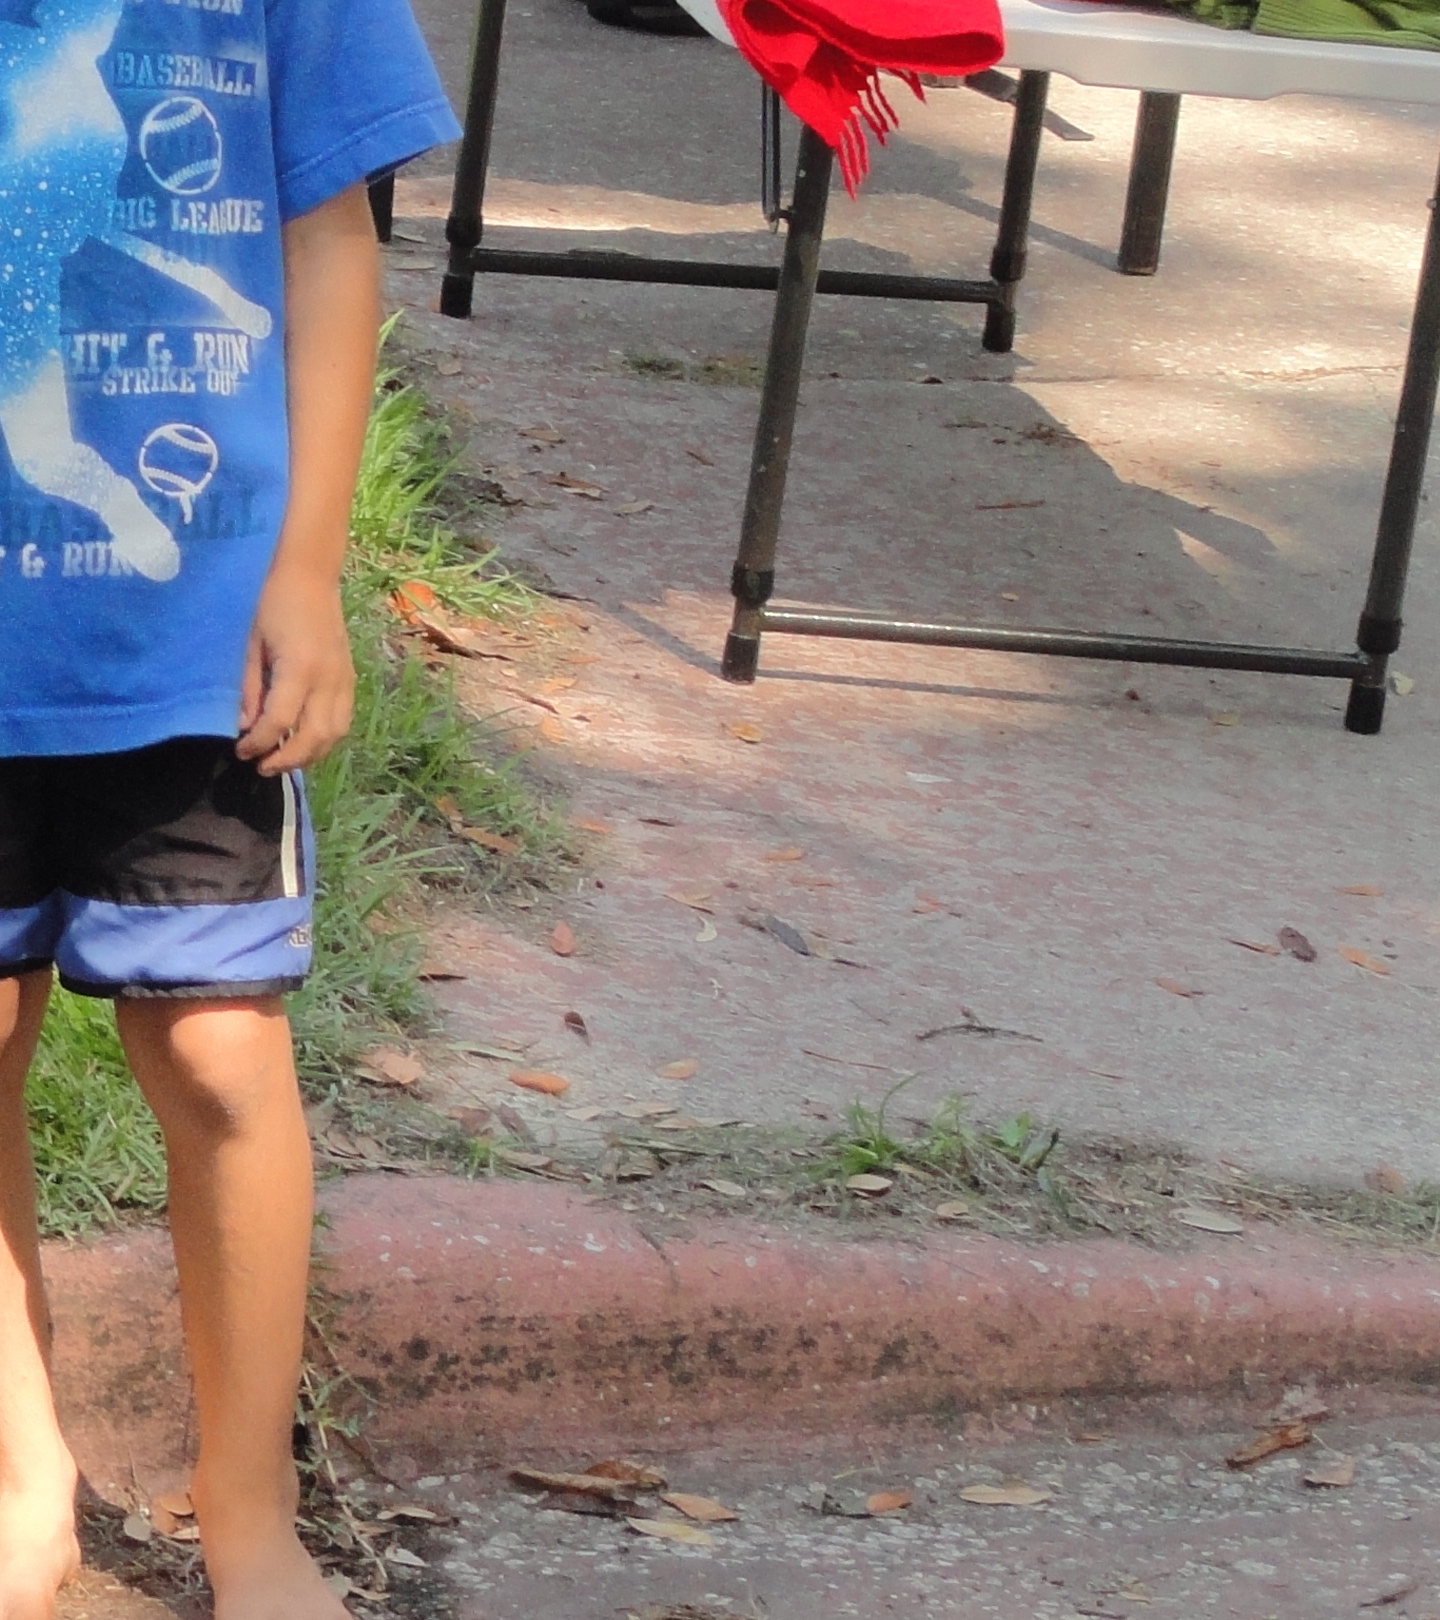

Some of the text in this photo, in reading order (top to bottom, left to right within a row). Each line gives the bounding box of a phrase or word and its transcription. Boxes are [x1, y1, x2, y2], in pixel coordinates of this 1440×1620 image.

[114, 51, 254, 97] BASEBALL
[193, 332, 251, 375] RUN
[101, 366, 197, 396] STRIKE
[21, 542, 47, 578] &
